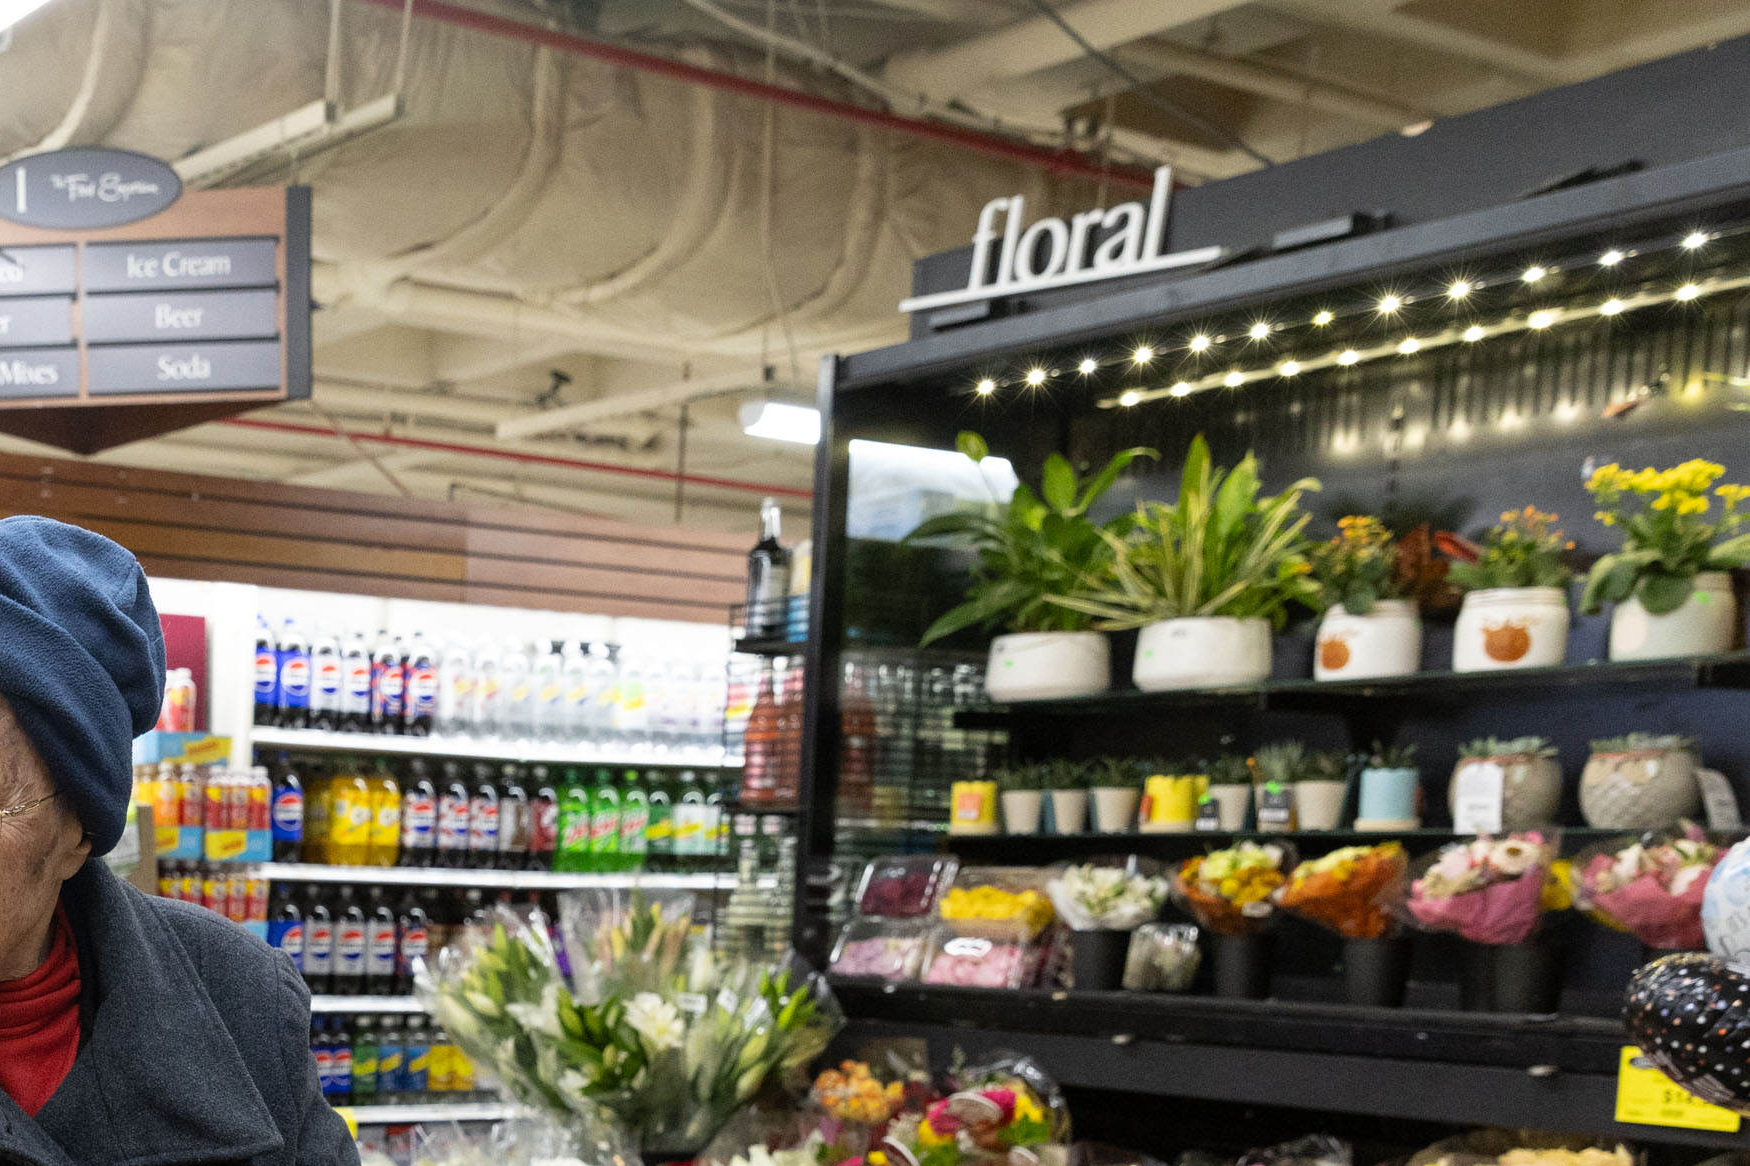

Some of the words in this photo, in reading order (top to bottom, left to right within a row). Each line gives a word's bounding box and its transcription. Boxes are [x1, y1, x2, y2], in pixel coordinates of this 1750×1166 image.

[967, 164, 1172, 291] floral
[126, 254, 158, 279] Ice
[161, 251, 232, 278] Cream
[154, 304, 204, 329] Beer
[157, 354, 212, 381] Soda
